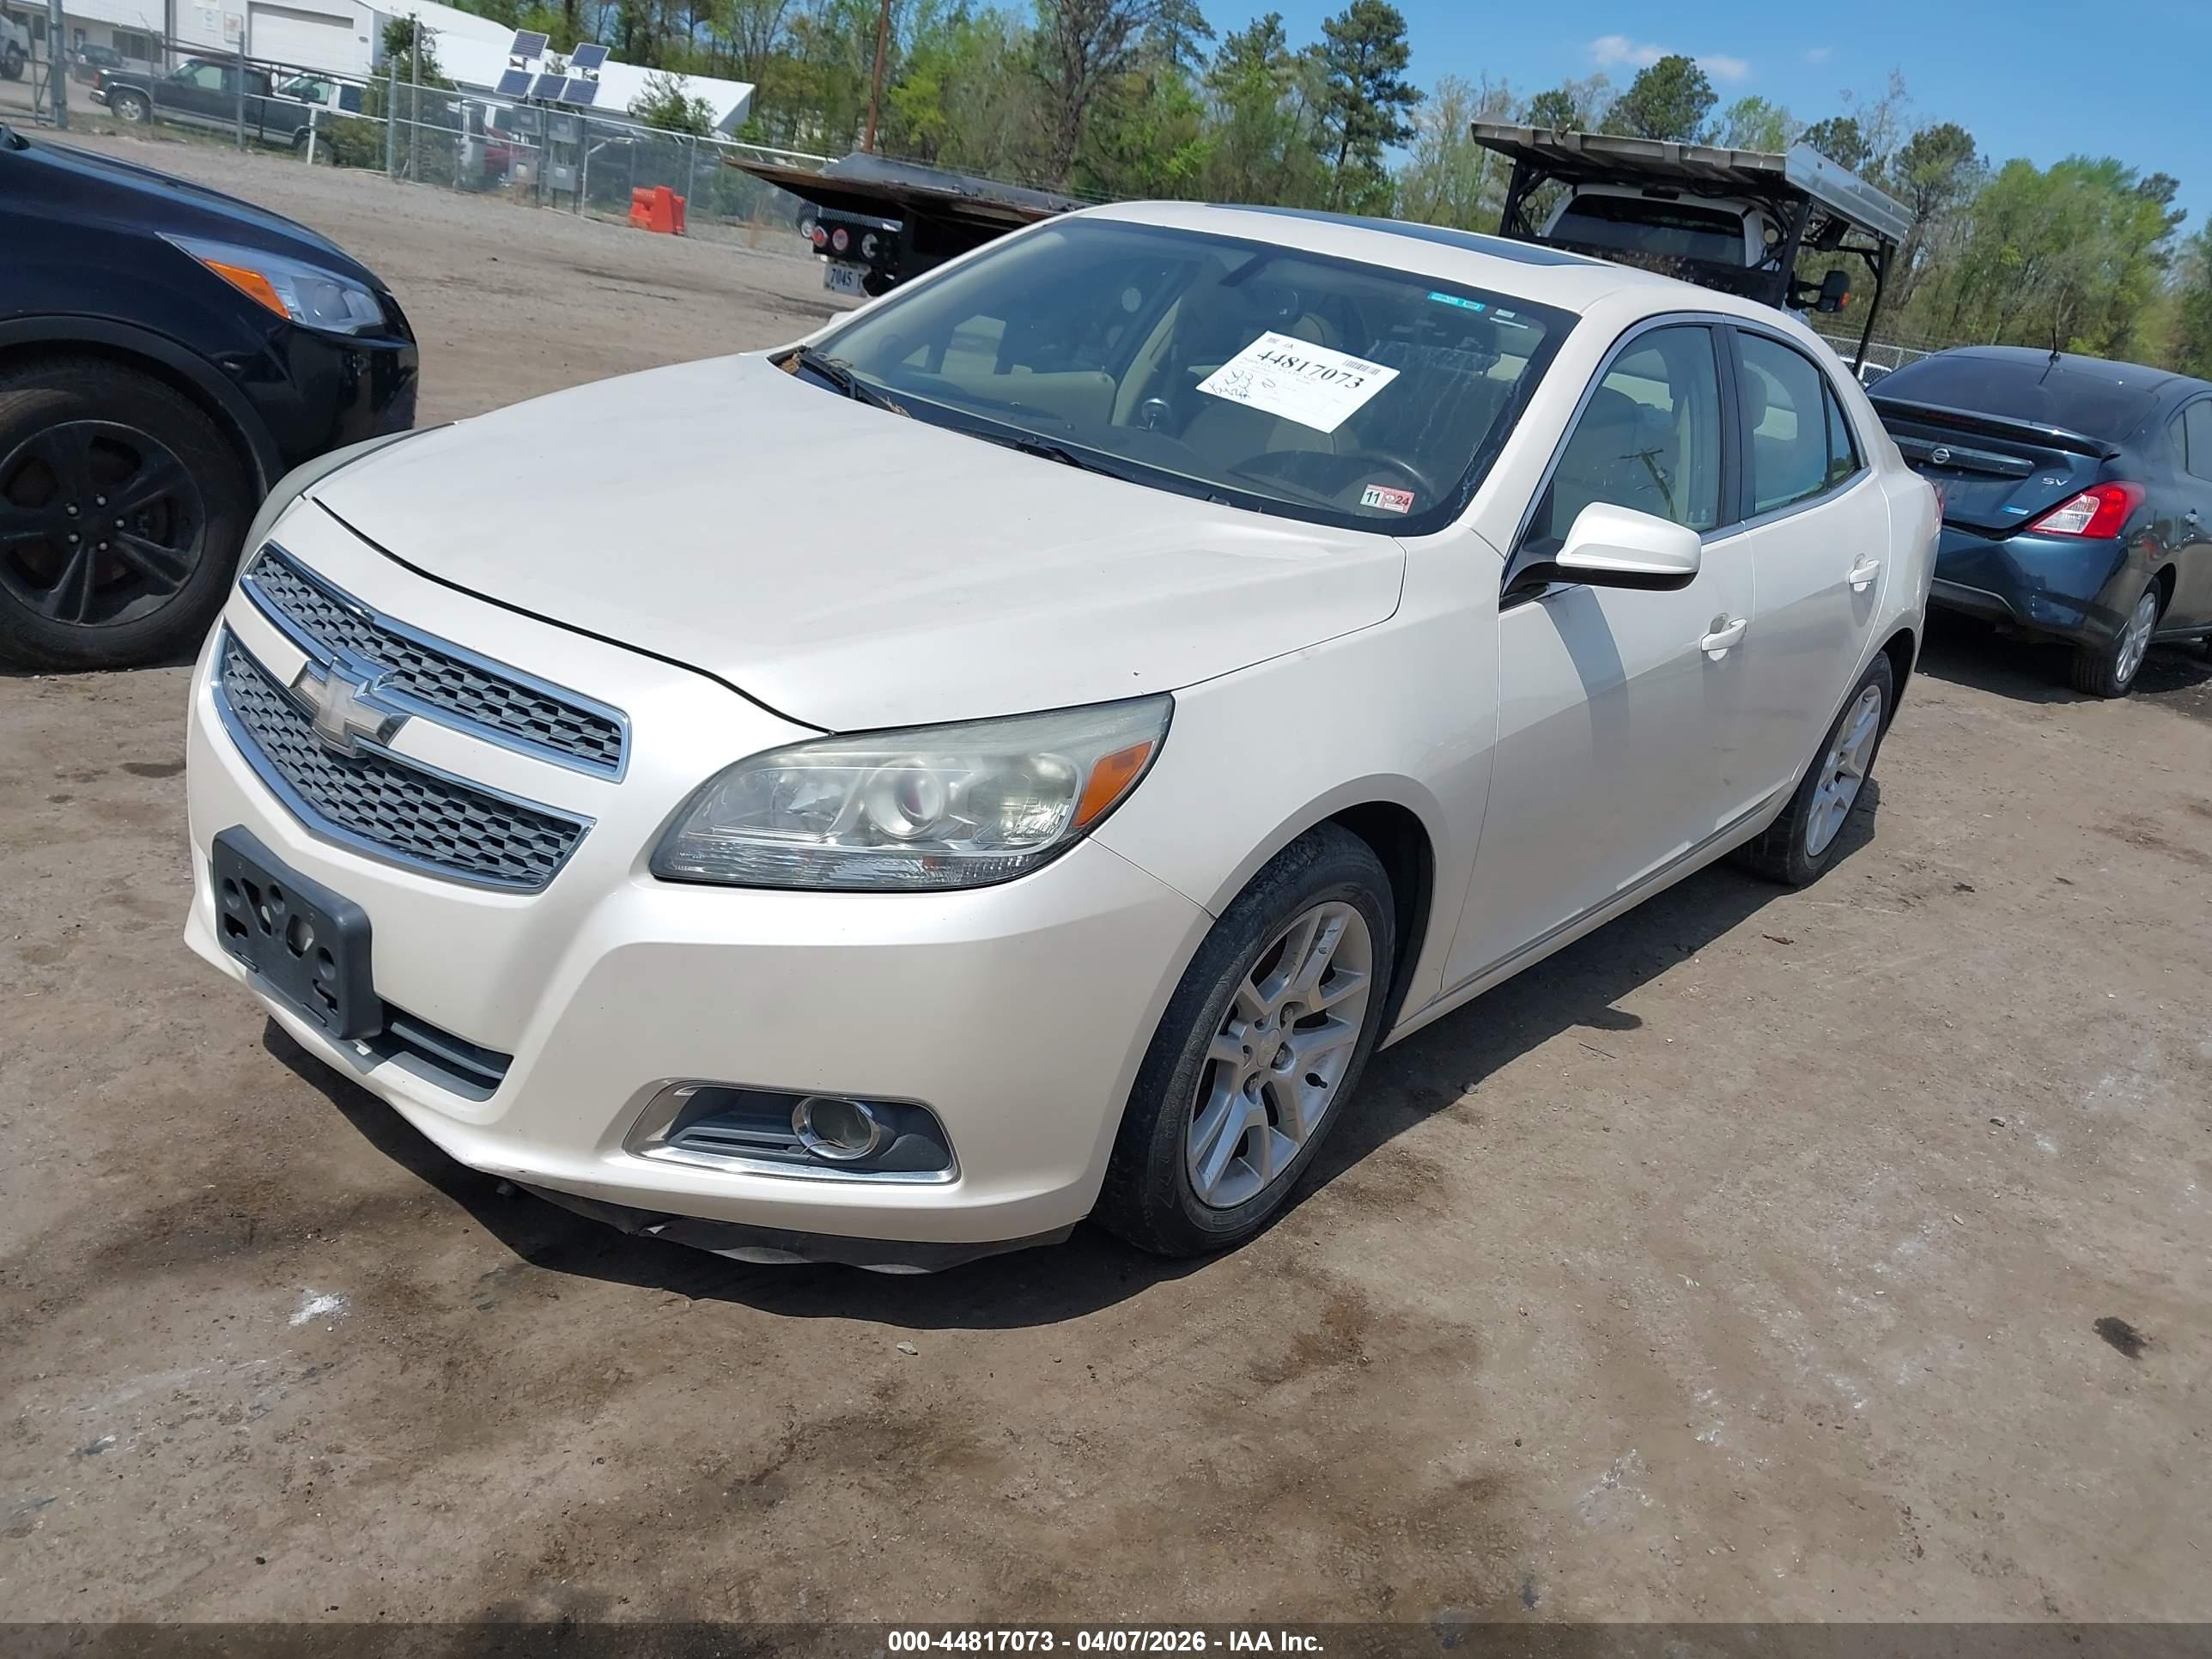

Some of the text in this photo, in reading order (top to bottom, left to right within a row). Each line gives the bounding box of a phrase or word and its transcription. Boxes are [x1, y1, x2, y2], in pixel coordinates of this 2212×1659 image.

[1256, 349, 1365, 390] 44817073
[2041, 477, 2069, 487] SV
[1366, 490, 1410, 507] 11 24
